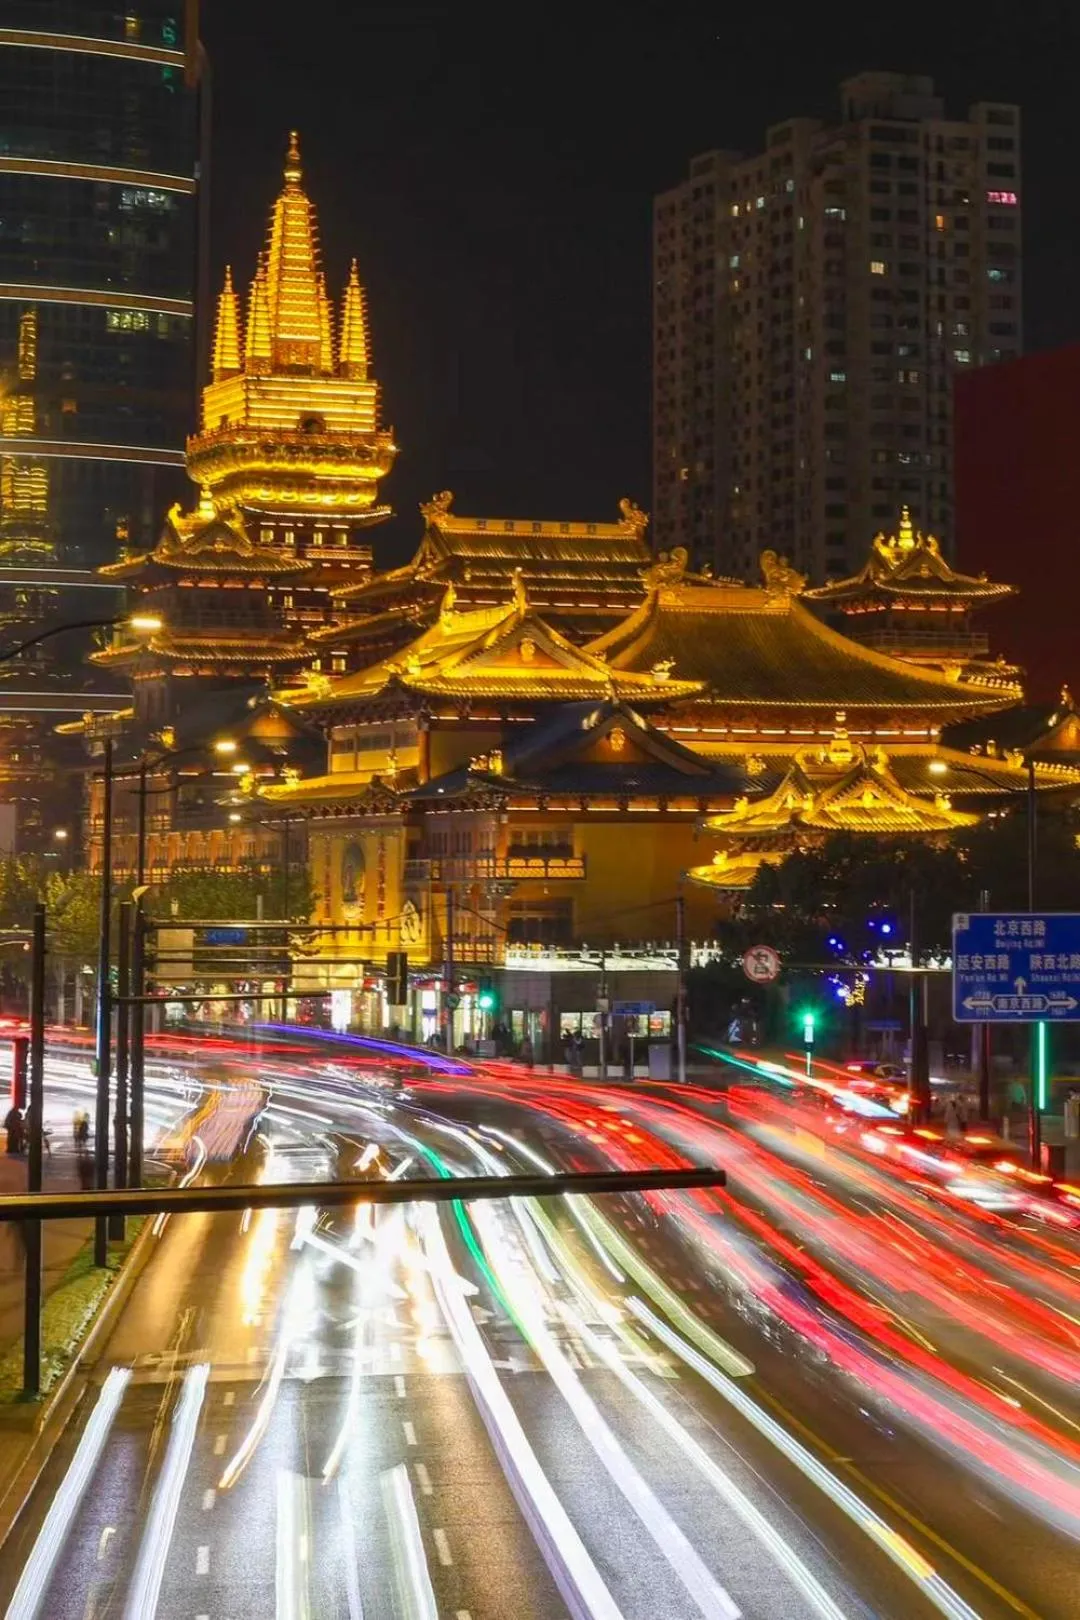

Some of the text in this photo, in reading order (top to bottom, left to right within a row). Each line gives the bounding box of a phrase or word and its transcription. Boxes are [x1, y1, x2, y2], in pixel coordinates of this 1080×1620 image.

[993, 920, 1046, 936] 北京西路
[957, 954, 1009, 970] 延安西路
